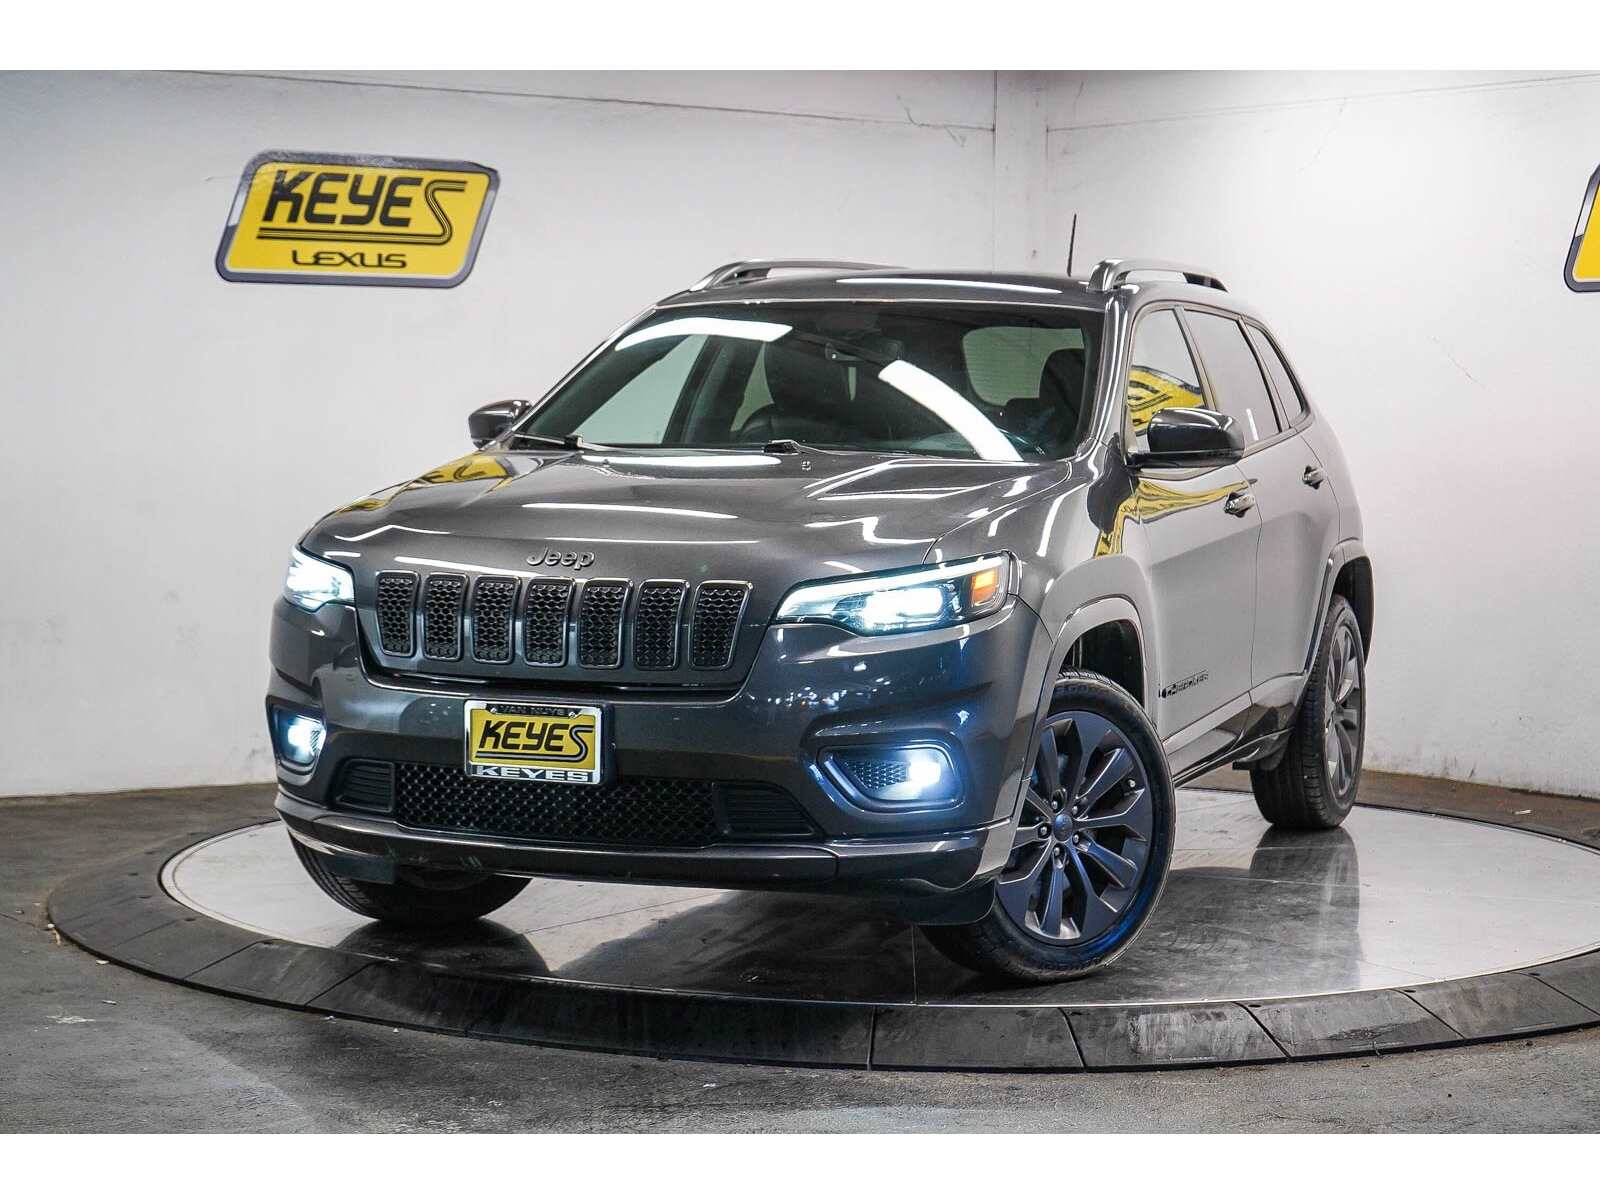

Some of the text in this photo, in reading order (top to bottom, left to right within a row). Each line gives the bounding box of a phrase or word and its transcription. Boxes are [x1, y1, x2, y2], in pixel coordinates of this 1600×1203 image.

[260, 169, 467, 245] KEYES
[292, 249, 407, 268] LEXUS
[526, 545, 595, 570] Jeep
[477, 720, 594, 763] KEYES
[476, 766, 588, 782] KEYES
